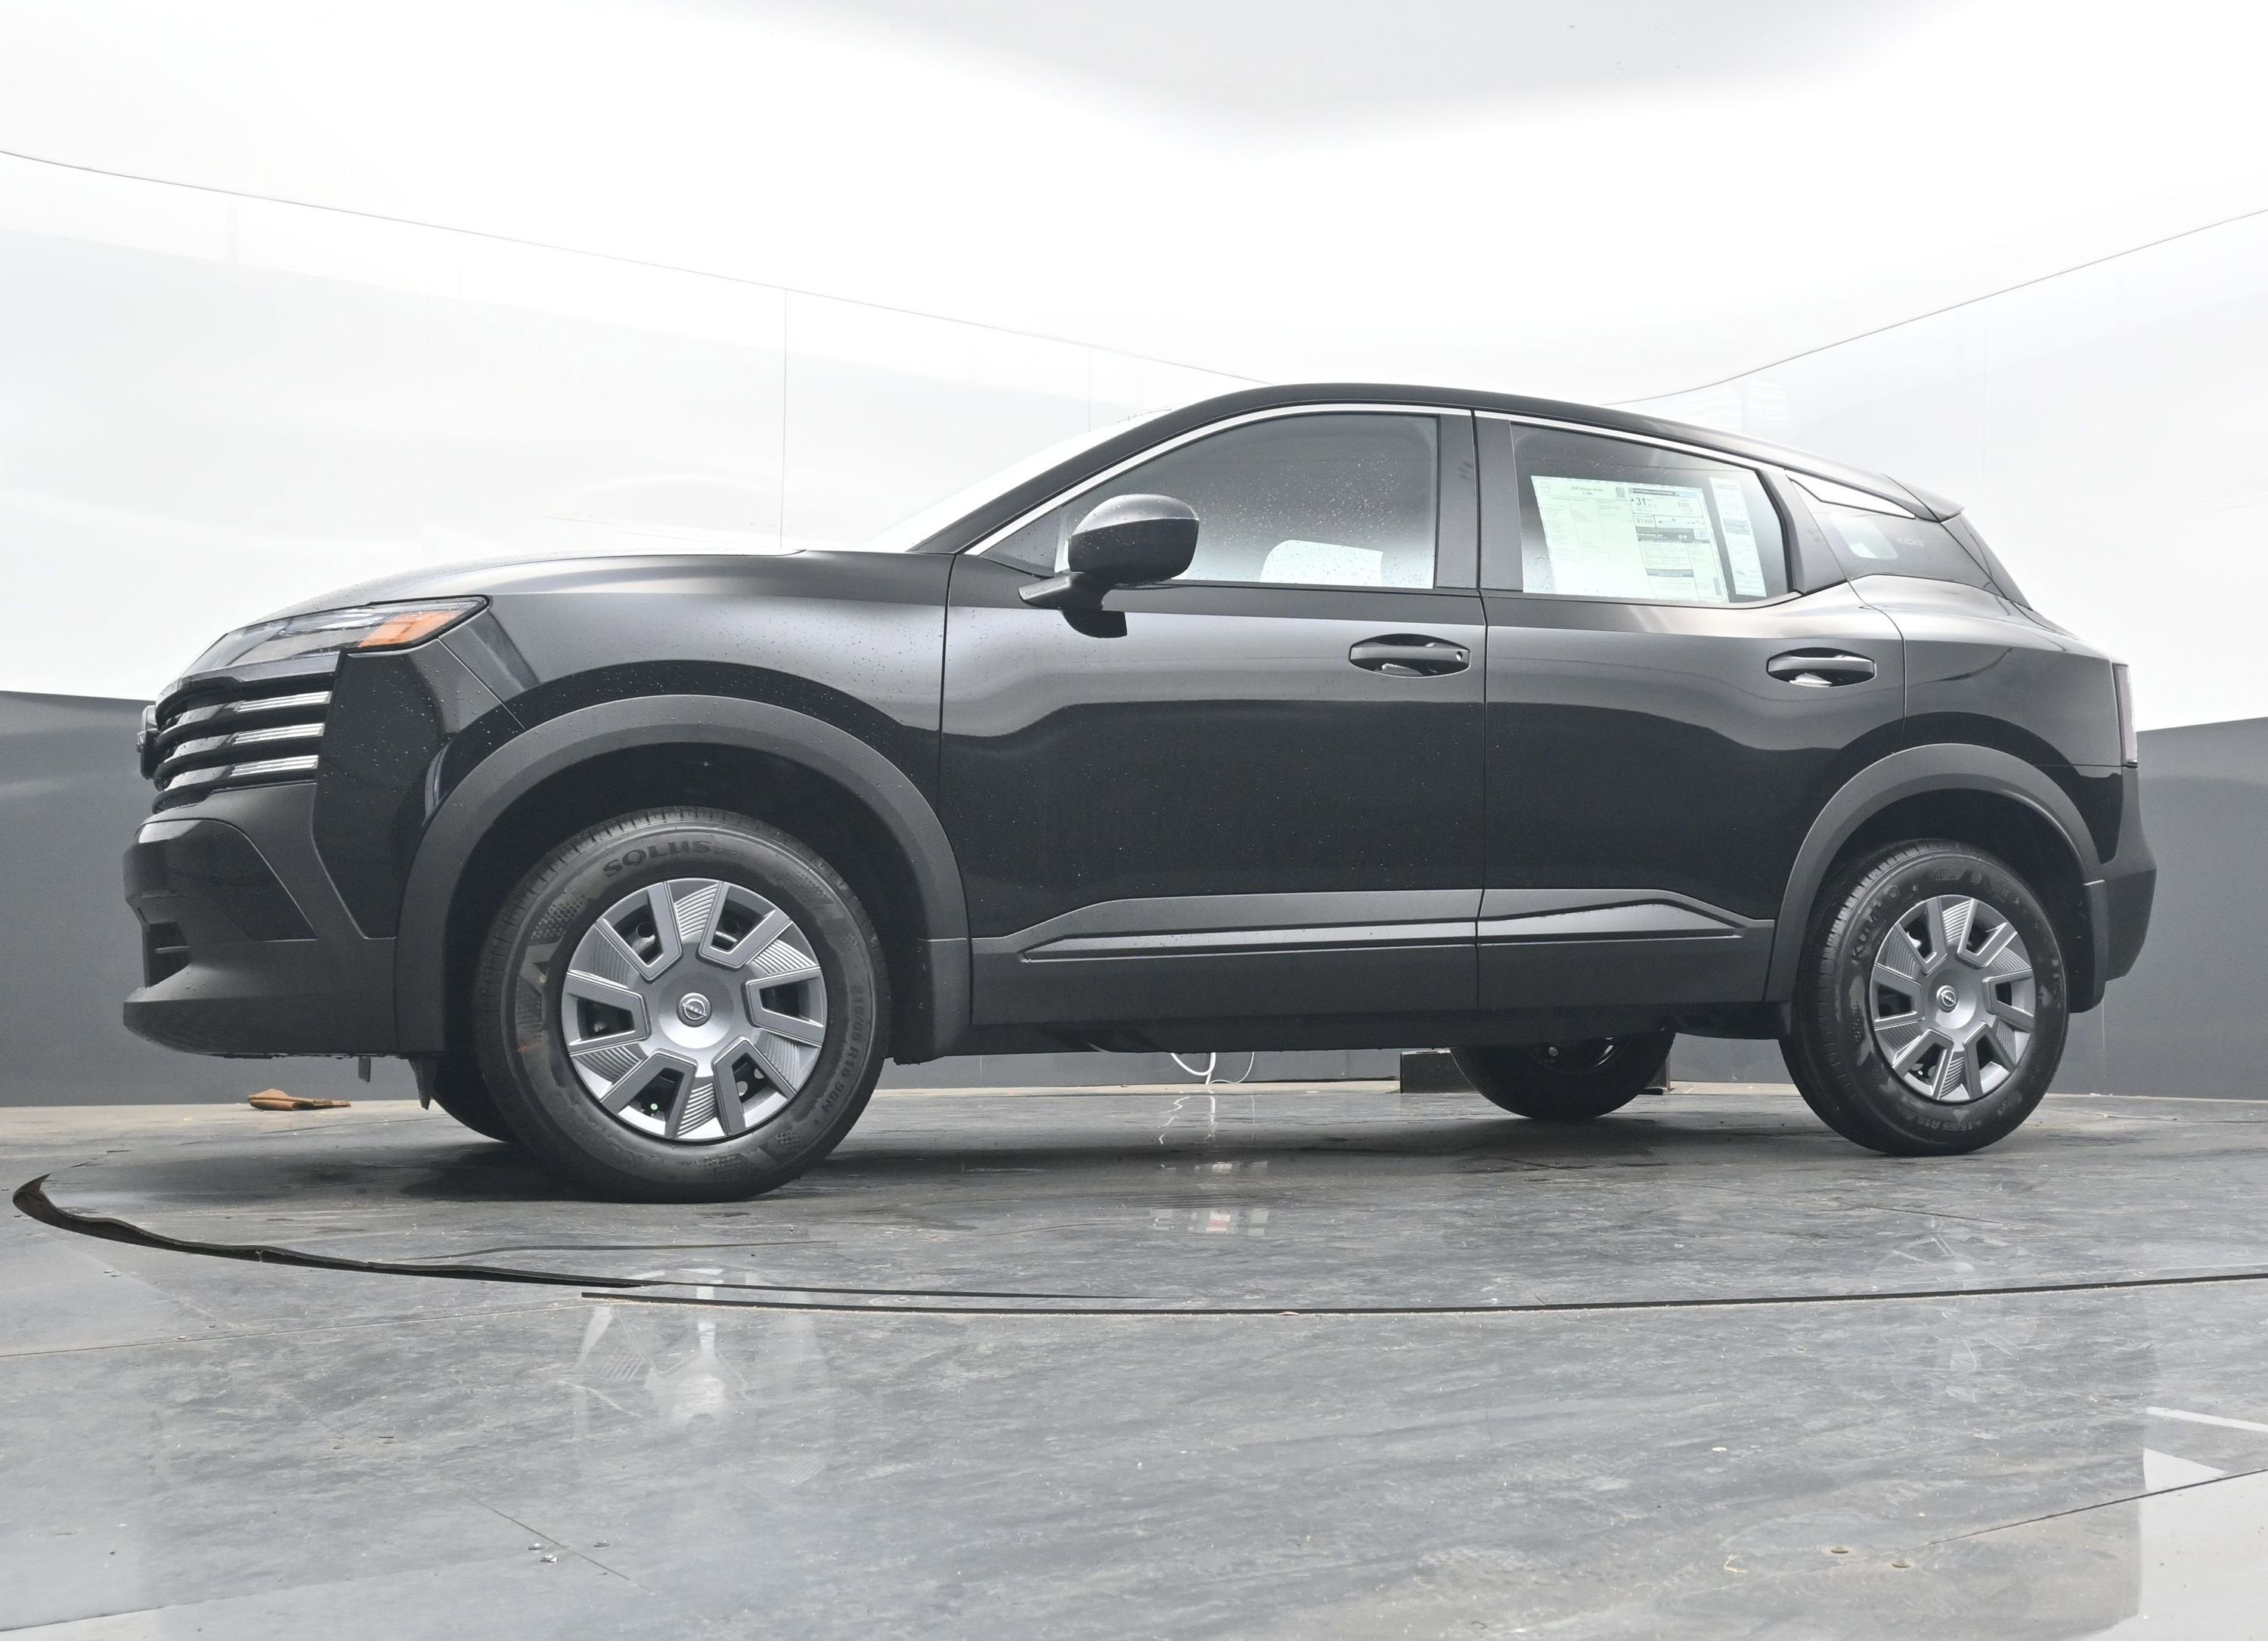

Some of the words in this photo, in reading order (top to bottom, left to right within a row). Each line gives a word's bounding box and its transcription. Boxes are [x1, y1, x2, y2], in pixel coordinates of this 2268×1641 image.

[1635, 497, 1647, 506] 31
[603, 841, 712, 878] SOLUS
[682, 1002, 707, 1017] NISSAN
[841, 1045, 860, 1079] R16
[821, 1081, 845, 1114] 98H
